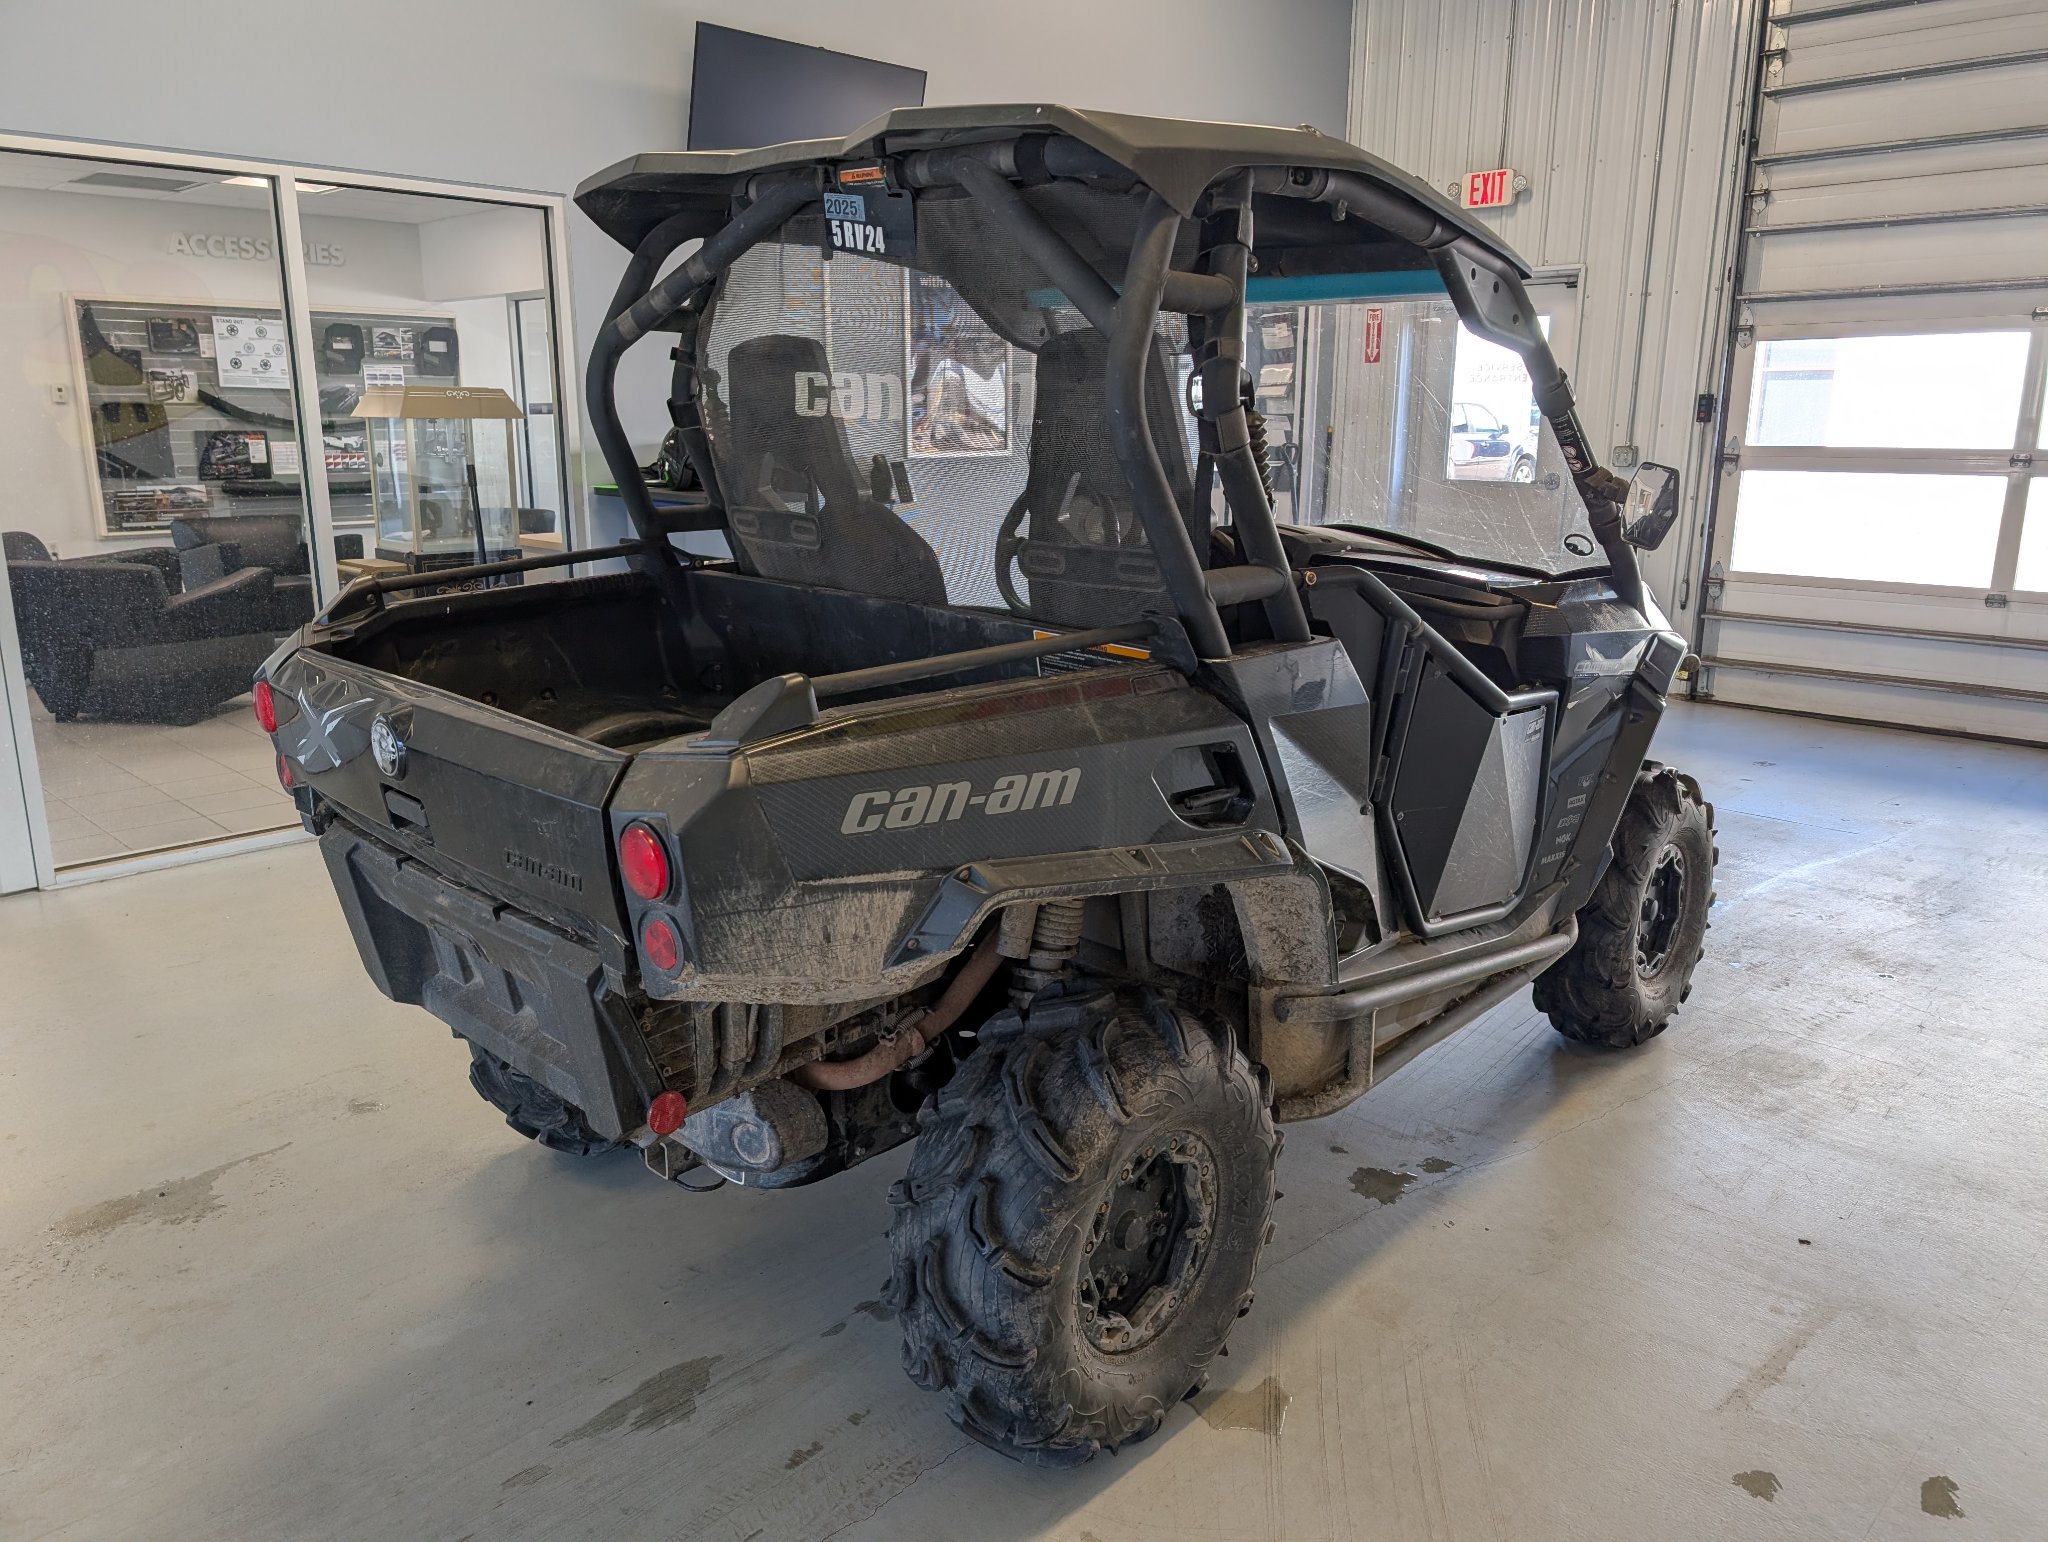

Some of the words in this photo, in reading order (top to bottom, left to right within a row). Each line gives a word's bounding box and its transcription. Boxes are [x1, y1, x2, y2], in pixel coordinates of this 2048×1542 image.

[1469, 171, 1507, 206] EXIT
[825, 199, 858, 216] 2025
[167, 231, 346, 267] ACCESSRIES
[840, 767, 1082, 835] can-am
[1540, 850, 1566, 865] MAXXIS
